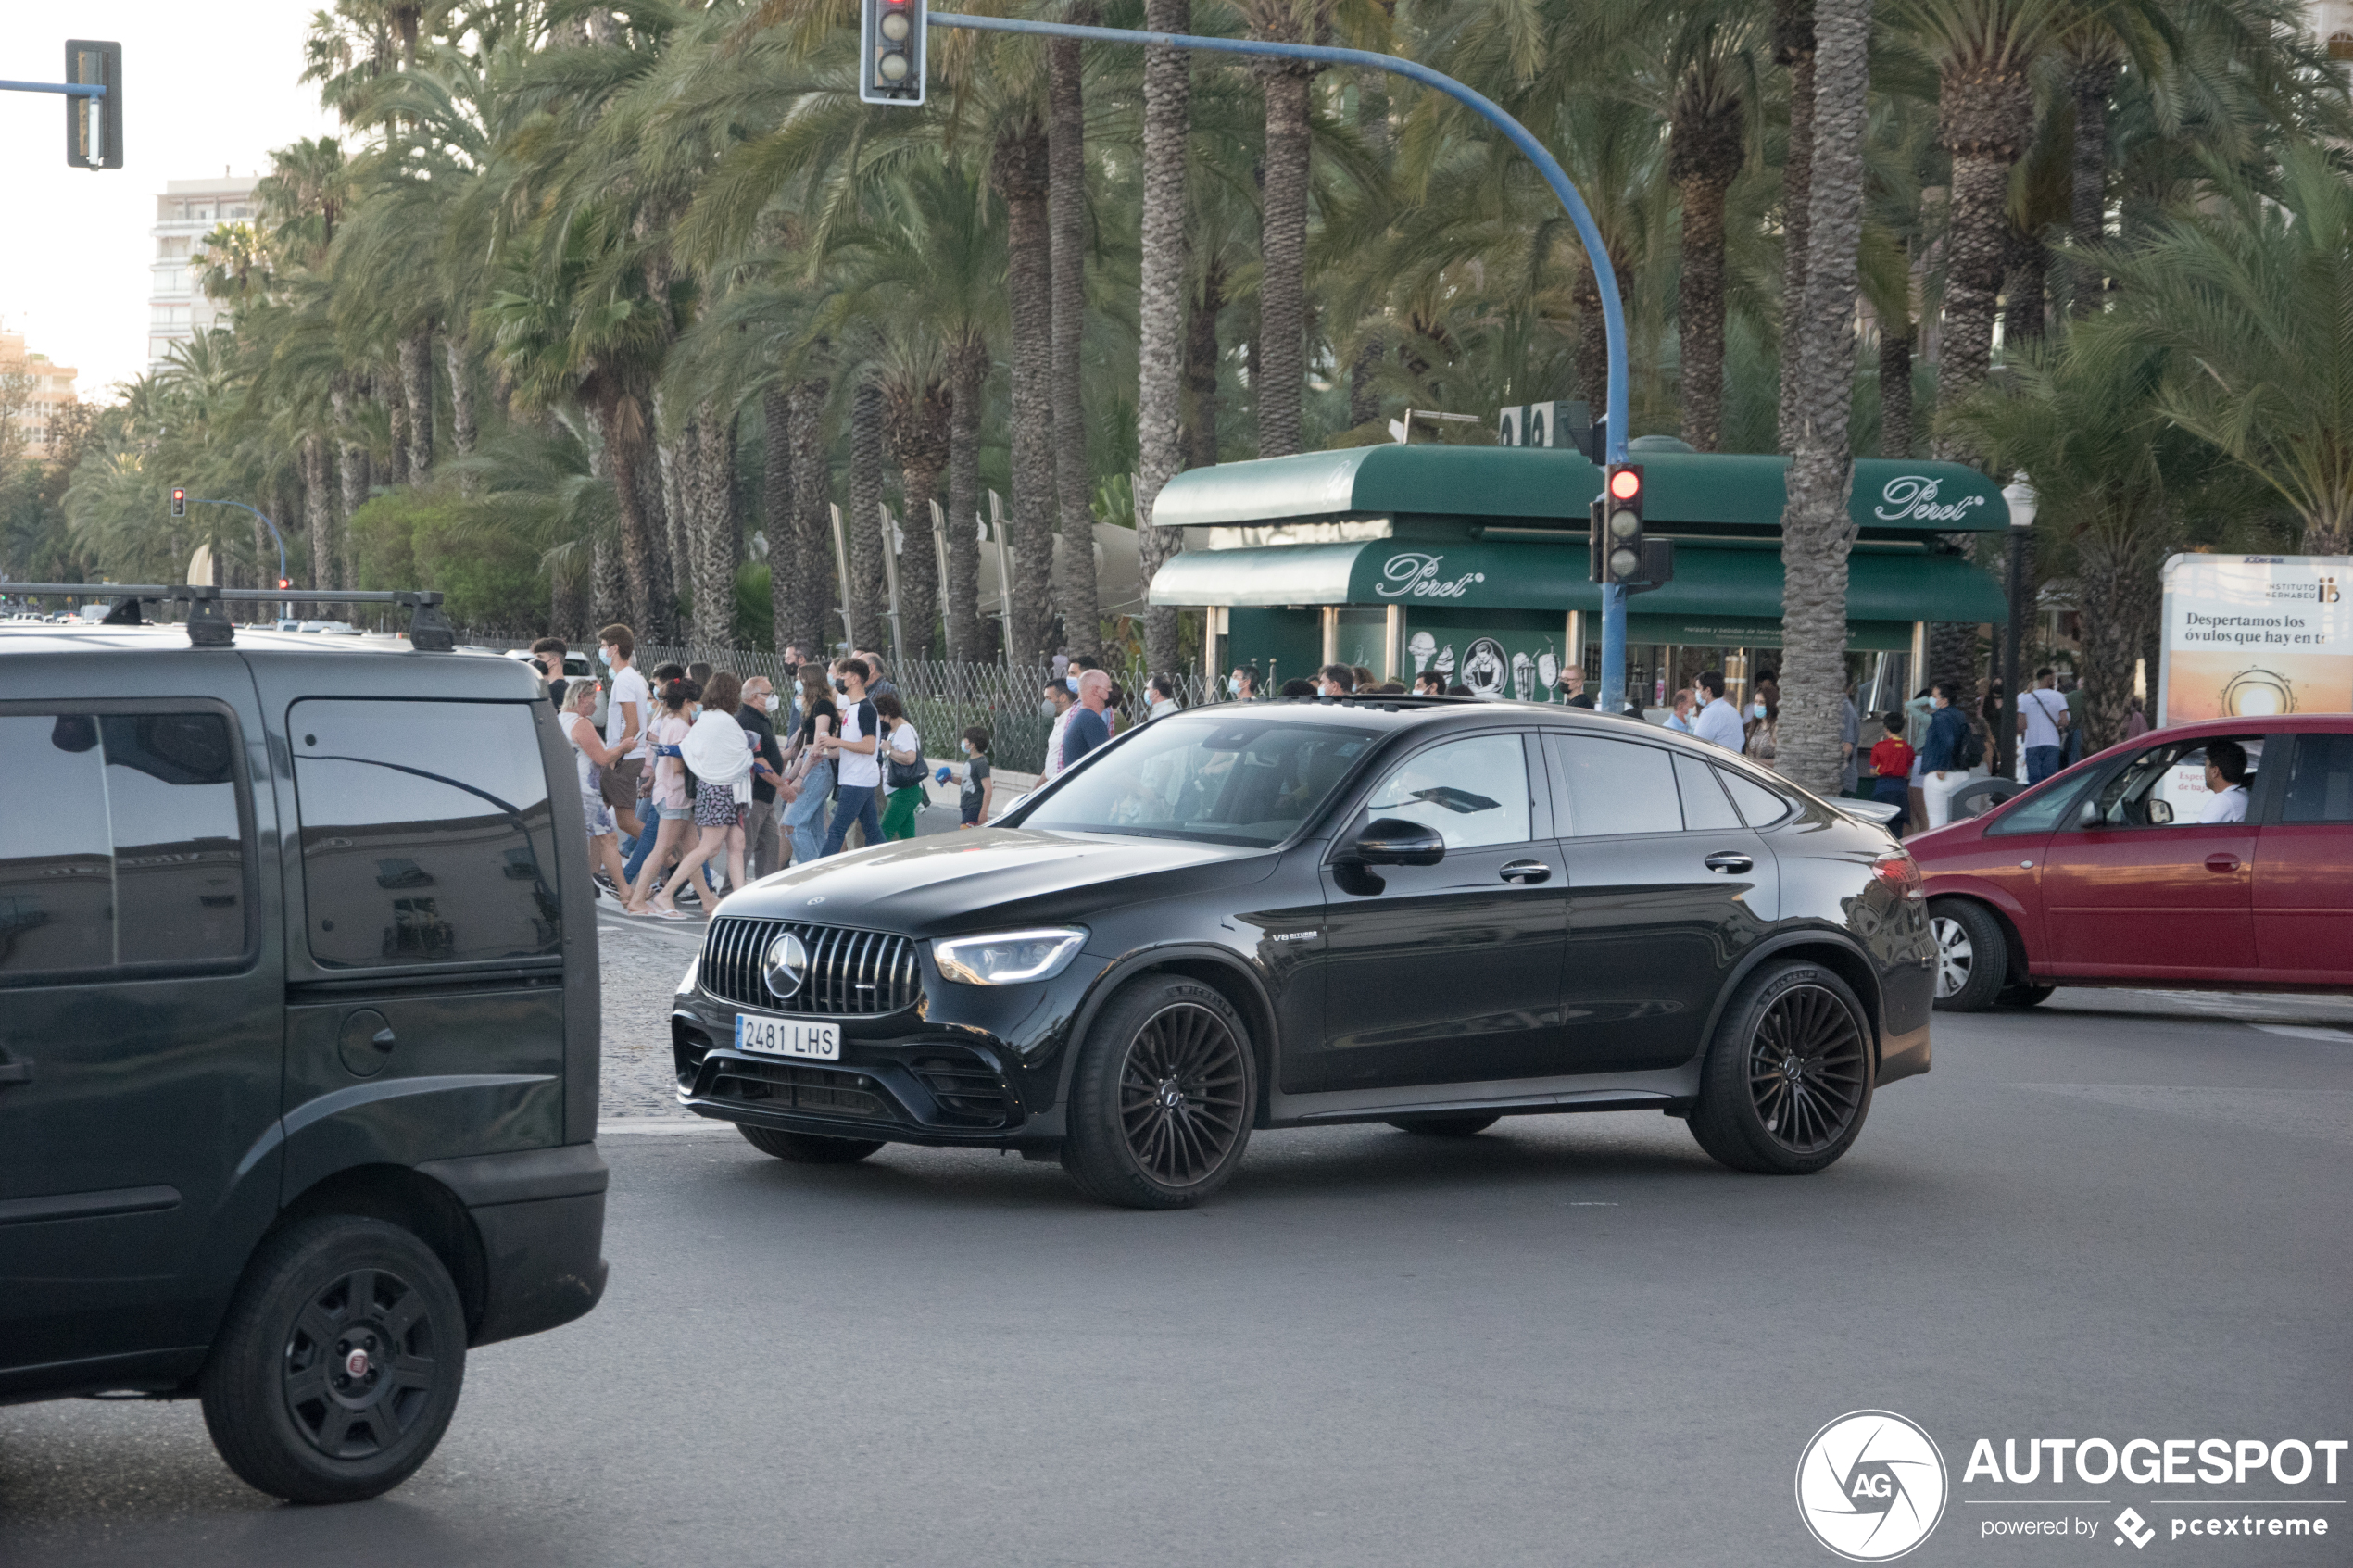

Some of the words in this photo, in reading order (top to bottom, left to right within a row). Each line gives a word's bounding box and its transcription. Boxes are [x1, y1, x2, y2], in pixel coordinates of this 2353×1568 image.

[2244, 556, 2284, 564] JCDecaux
[2186, 612, 2281, 629] Despertamos
[2284, 615, 2305, 628] los
[2185, 627, 2232, 642] óvulos
[2234, 633, 2261, 645] que
[2264, 631, 2293, 646] hay
[2294, 633, 2310, 644] en
[2179, 771, 2205, 782] Espec
[1272, 934, 1290, 942] V8
[746, 1022, 785, 1051] 2481
[795, 1026, 833, 1055] LHS
